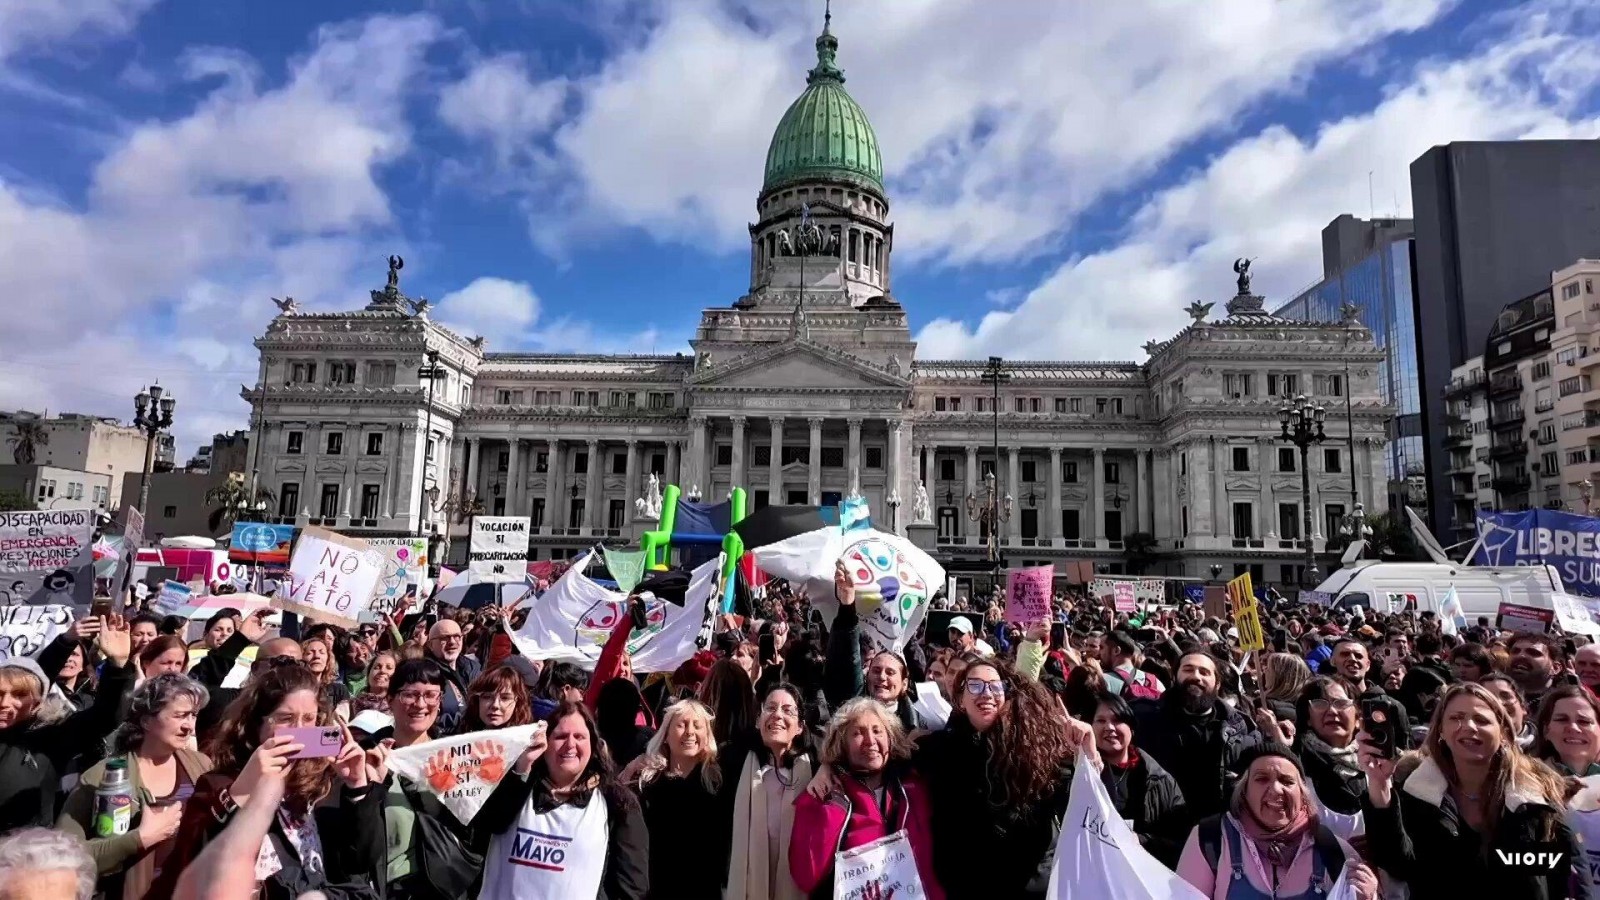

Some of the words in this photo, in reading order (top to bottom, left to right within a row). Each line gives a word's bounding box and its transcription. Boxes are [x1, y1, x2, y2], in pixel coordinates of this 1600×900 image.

[0, 512, 84, 527] DISCAPACIDAD
[480, 520, 524, 531] VOCACIÓN
[28, 528, 43, 536] EN
[29, 559, 69, 567] RIESGO
[493, 564, 504, 573] NO
[313, 569, 339, 588] AL
[289, 579, 352, 611] VETO
[451, 743, 471, 758] NO
[456, 771, 470, 784] SI
[511, 833, 564, 864] MAYO
